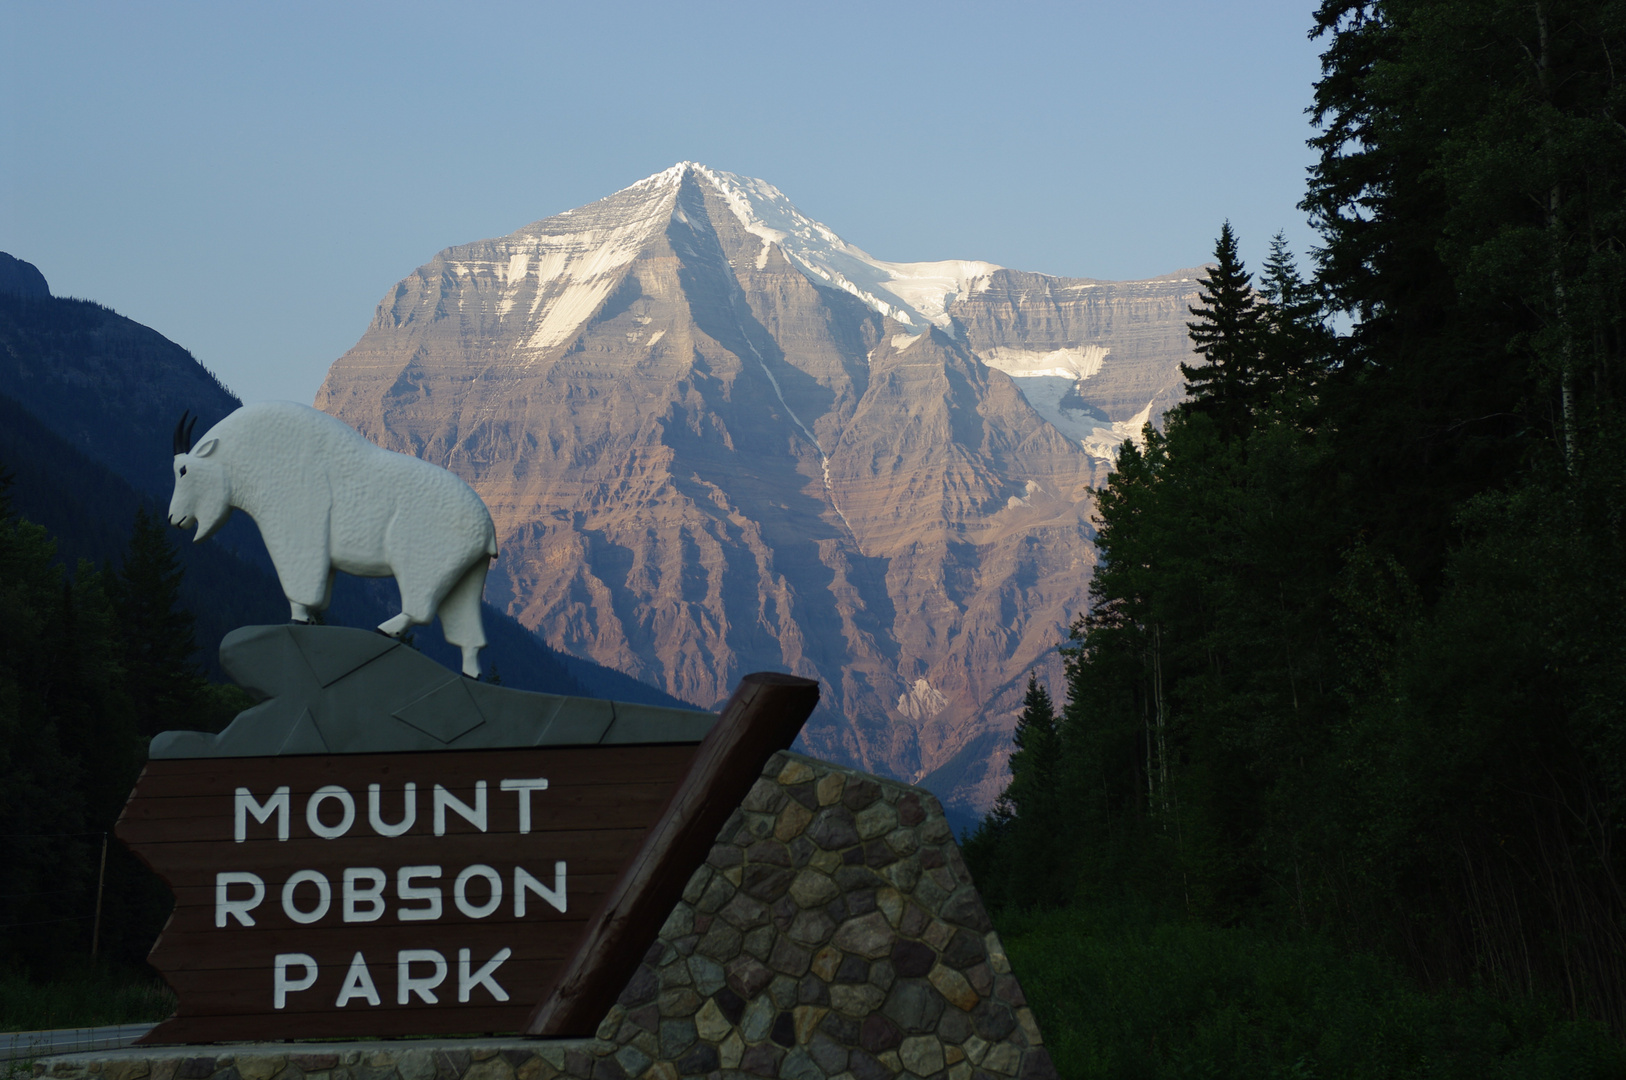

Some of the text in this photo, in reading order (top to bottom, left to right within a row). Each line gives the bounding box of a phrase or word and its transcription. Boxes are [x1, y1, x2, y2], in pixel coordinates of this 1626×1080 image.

[234, 778, 549, 843] MOUNT
[215, 861, 567, 928] ROBSON
[274, 947, 512, 1009] PARK
